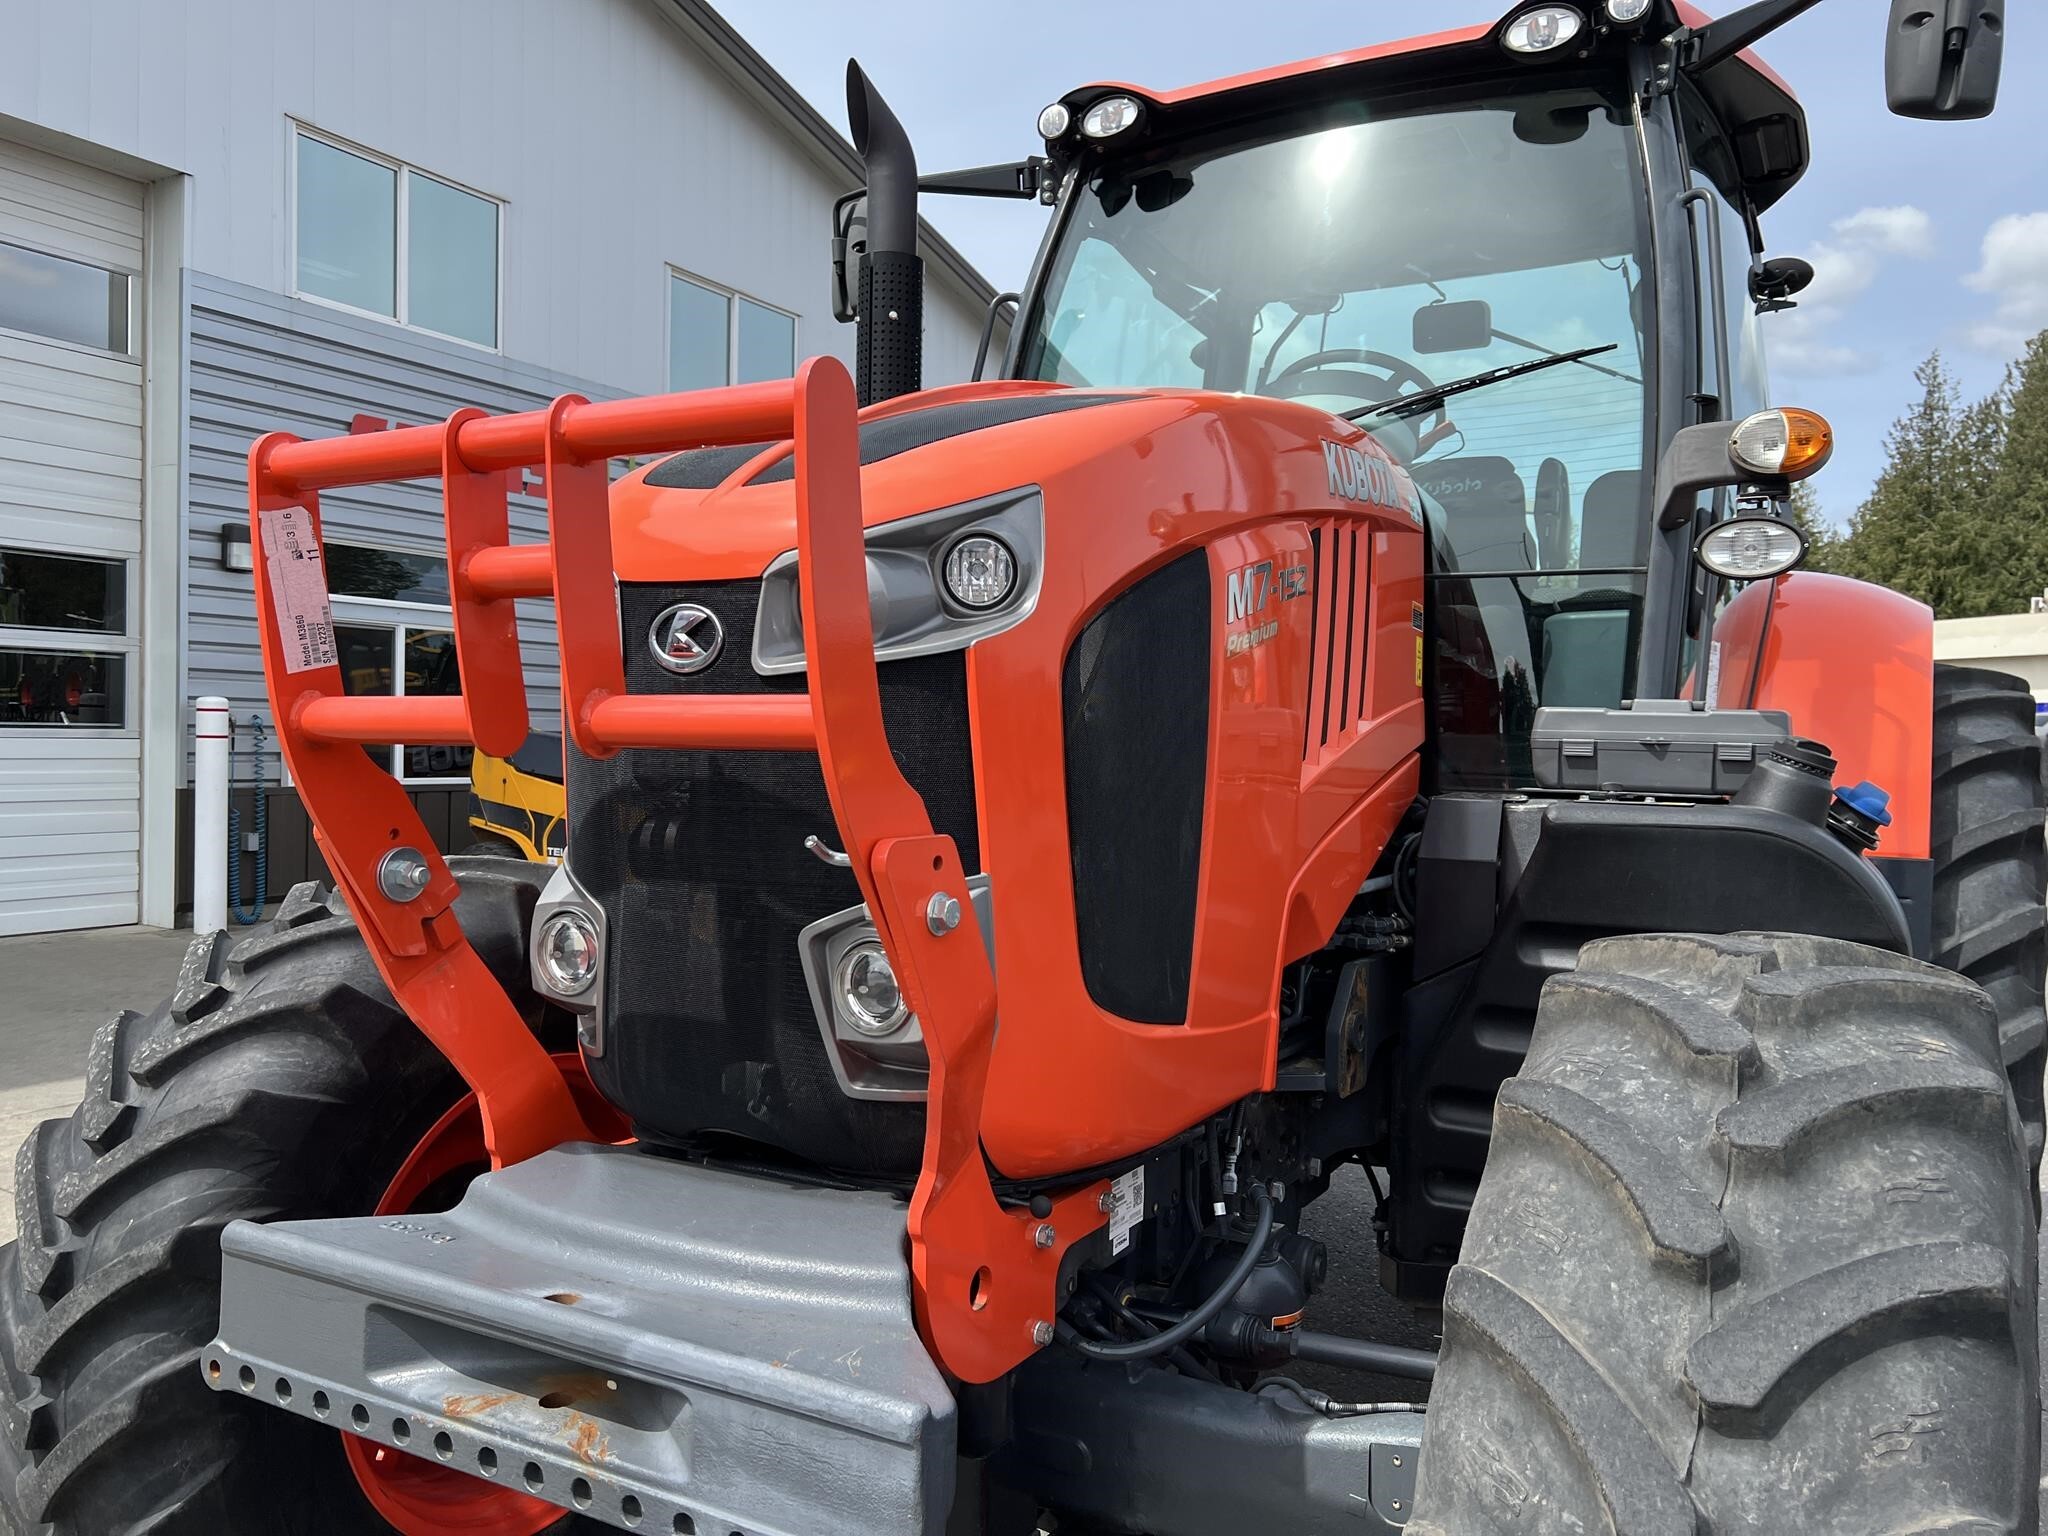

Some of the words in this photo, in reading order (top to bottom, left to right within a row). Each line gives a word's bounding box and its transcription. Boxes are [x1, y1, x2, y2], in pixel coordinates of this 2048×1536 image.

[1319, 438, 1401, 510] KUBOTA
[295, 614, 309, 641] M3860
[316, 622, 329, 646] A2237
[1227, 618, 1278, 657] Premium
[300, 642, 313, 667] Model
[320, 650, 332, 664] S/N
